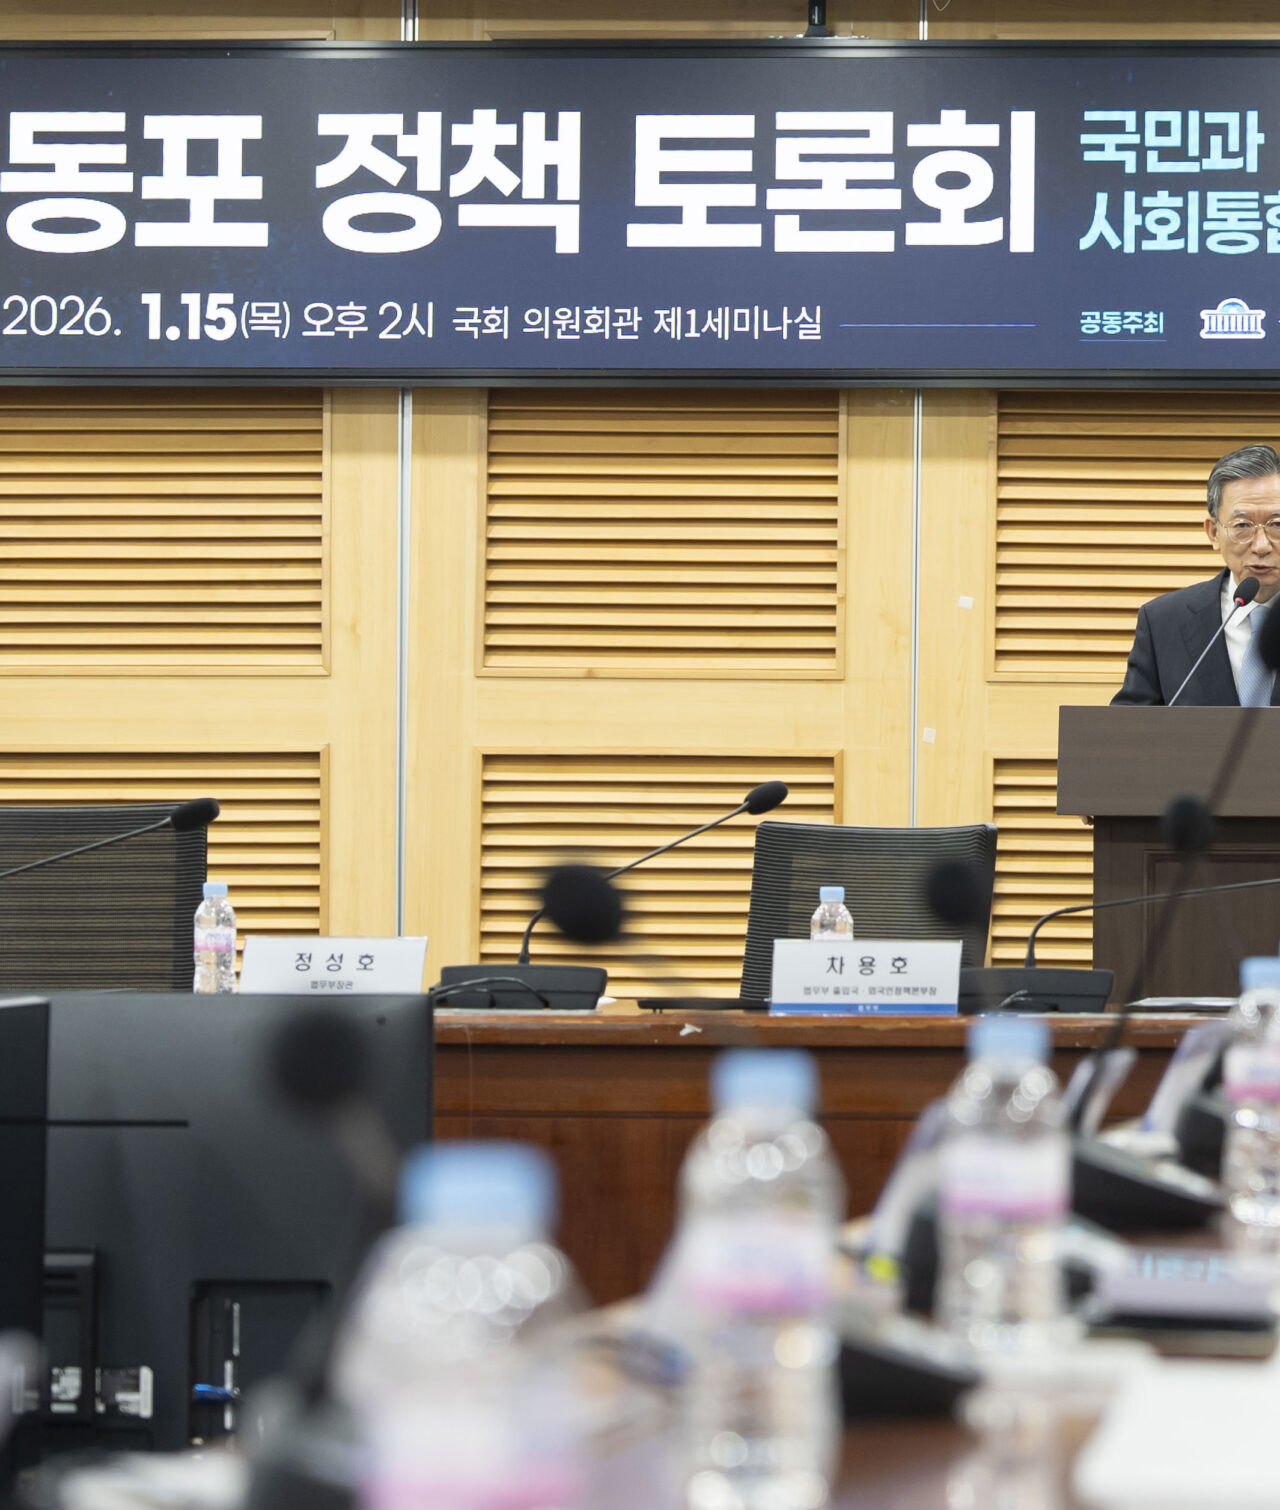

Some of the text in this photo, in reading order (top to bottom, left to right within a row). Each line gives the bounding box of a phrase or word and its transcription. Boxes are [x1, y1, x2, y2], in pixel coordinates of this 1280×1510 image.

[1079, 109, 1266, 174] 국민과
[0, 108, 1036, 254] 동포 정책 토론회
[2, 294, 122, 338] 2026.
[301, 300, 369, 339] 오후
[378, 301, 434, 340] 2시
[452, 305, 509, 340] 국회
[522, 305, 643, 340] 의원회관
[653, 305, 822, 341] 제1세미나실
[1079, 310, 1164, 335] 공동주최
